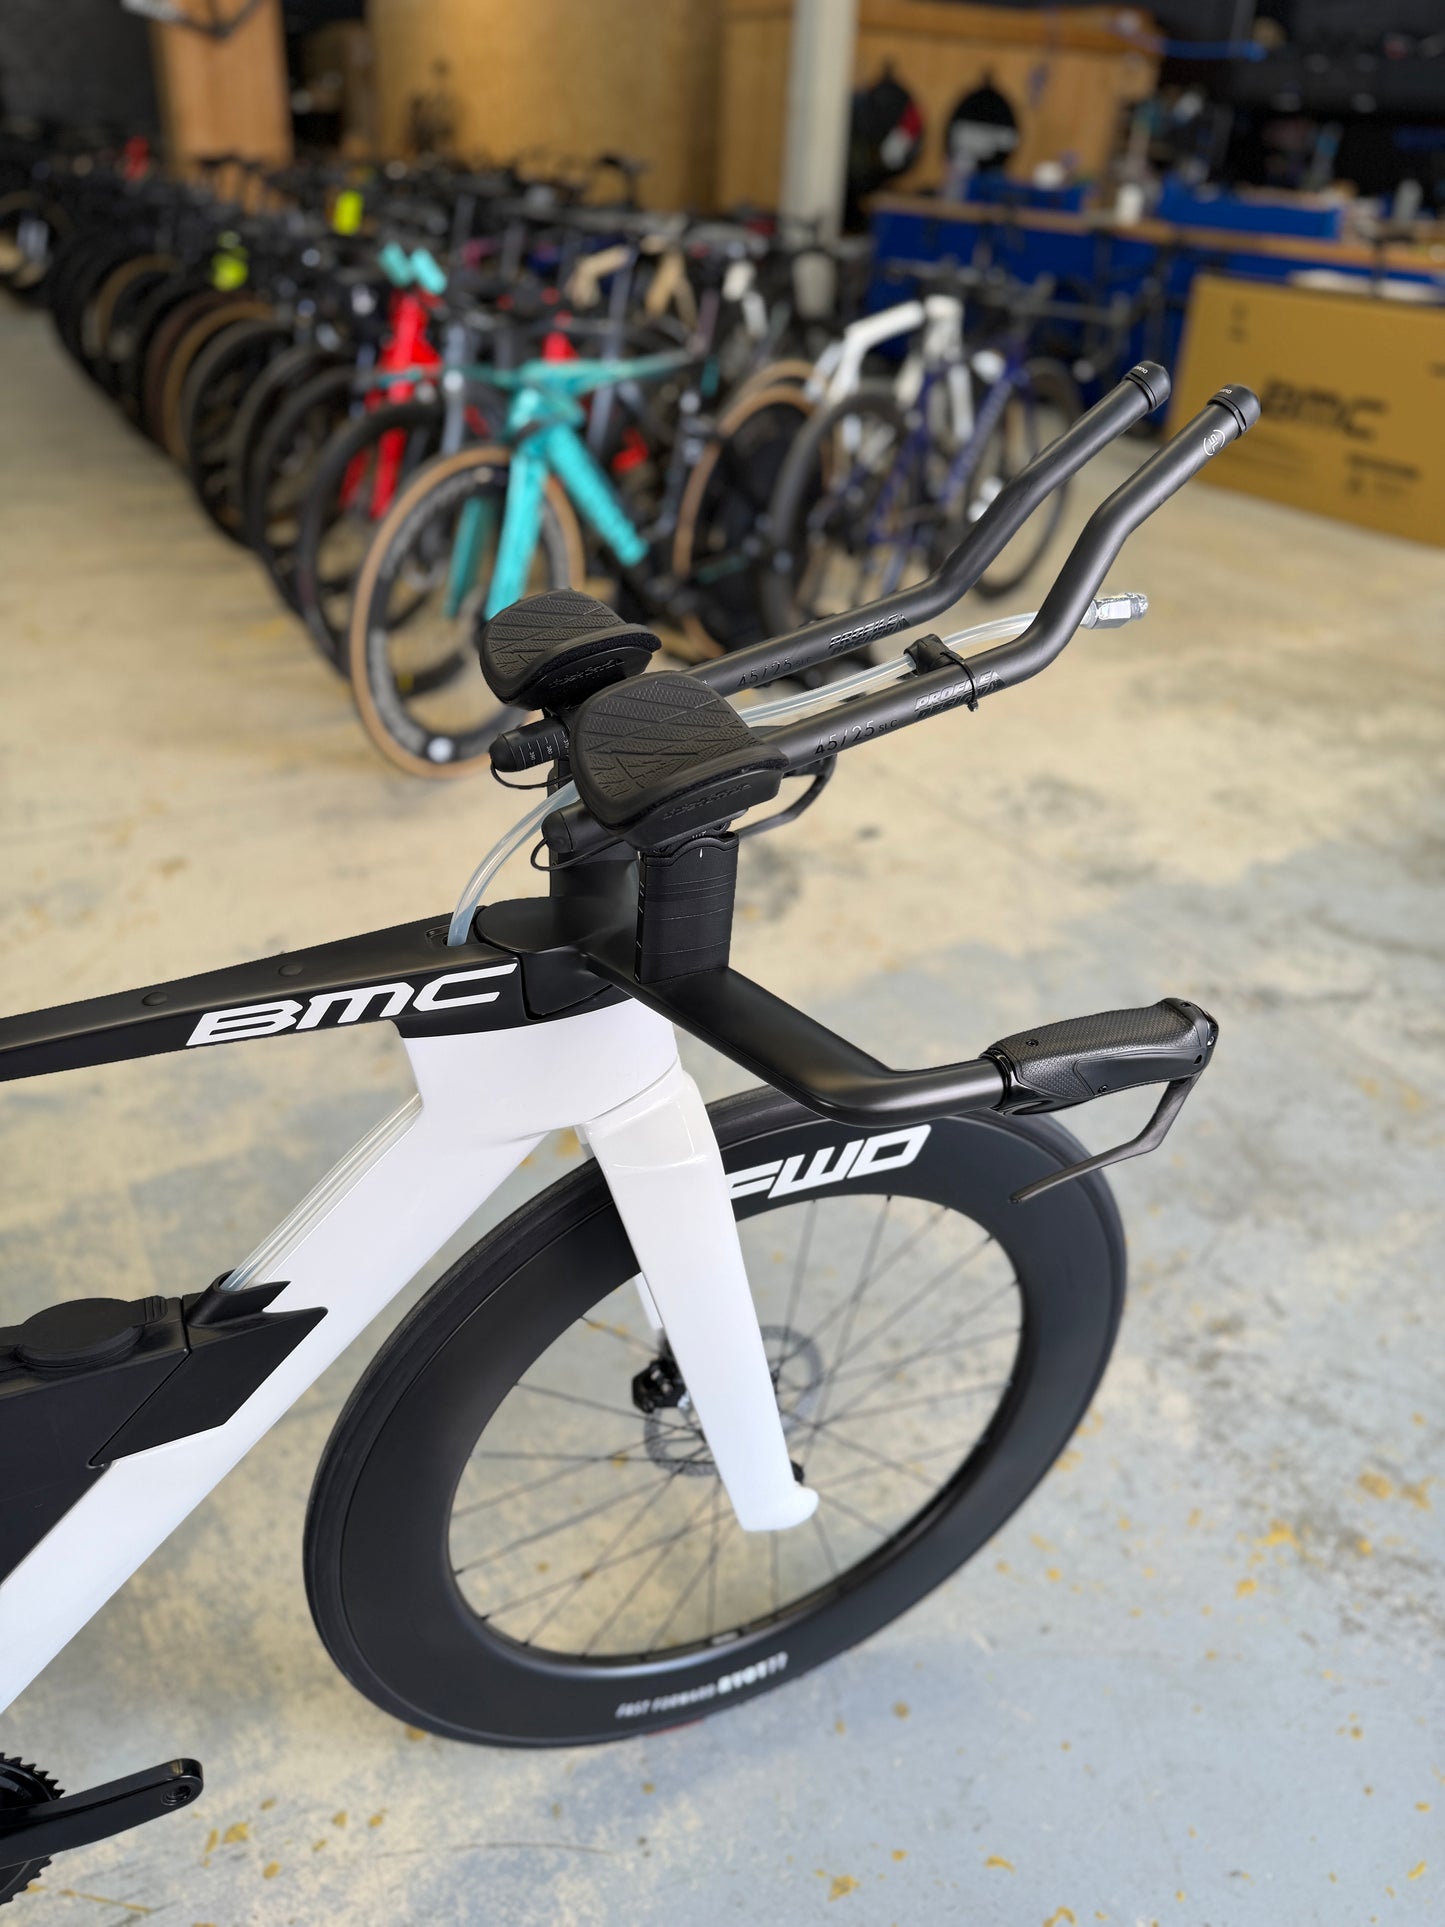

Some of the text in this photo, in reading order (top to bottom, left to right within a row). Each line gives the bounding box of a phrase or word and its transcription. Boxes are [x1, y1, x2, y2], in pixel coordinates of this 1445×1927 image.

[814, 719, 898, 755] 45/25 SLC
[186, 963, 518, 1046] BMC
[615, 1699, 650, 1719] FAST
